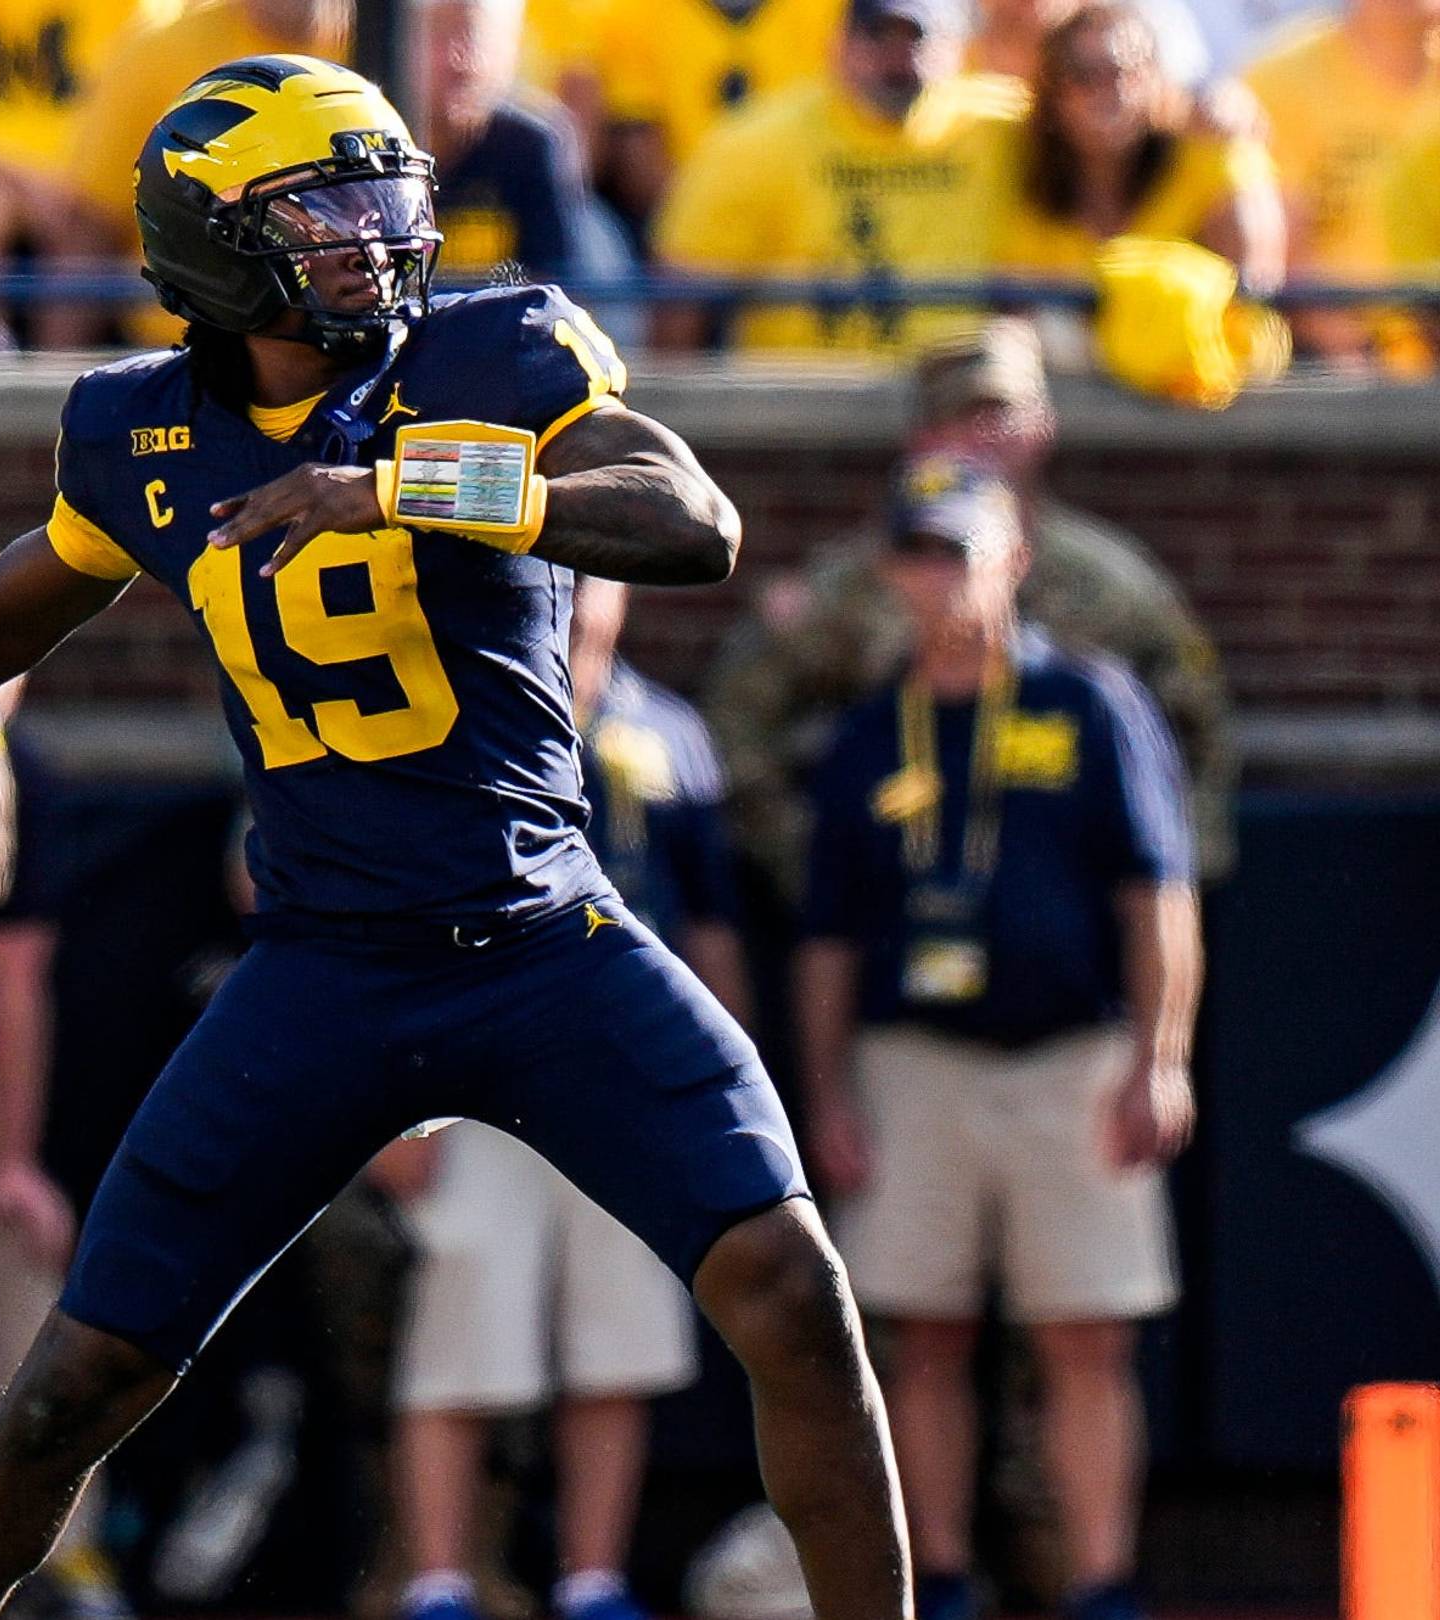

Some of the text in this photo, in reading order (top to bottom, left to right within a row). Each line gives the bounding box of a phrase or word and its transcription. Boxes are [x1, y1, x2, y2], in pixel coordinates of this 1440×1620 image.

[361, 132, 387, 151] M
[145, 479, 174, 528] C
[187, 527, 459, 770] 19
